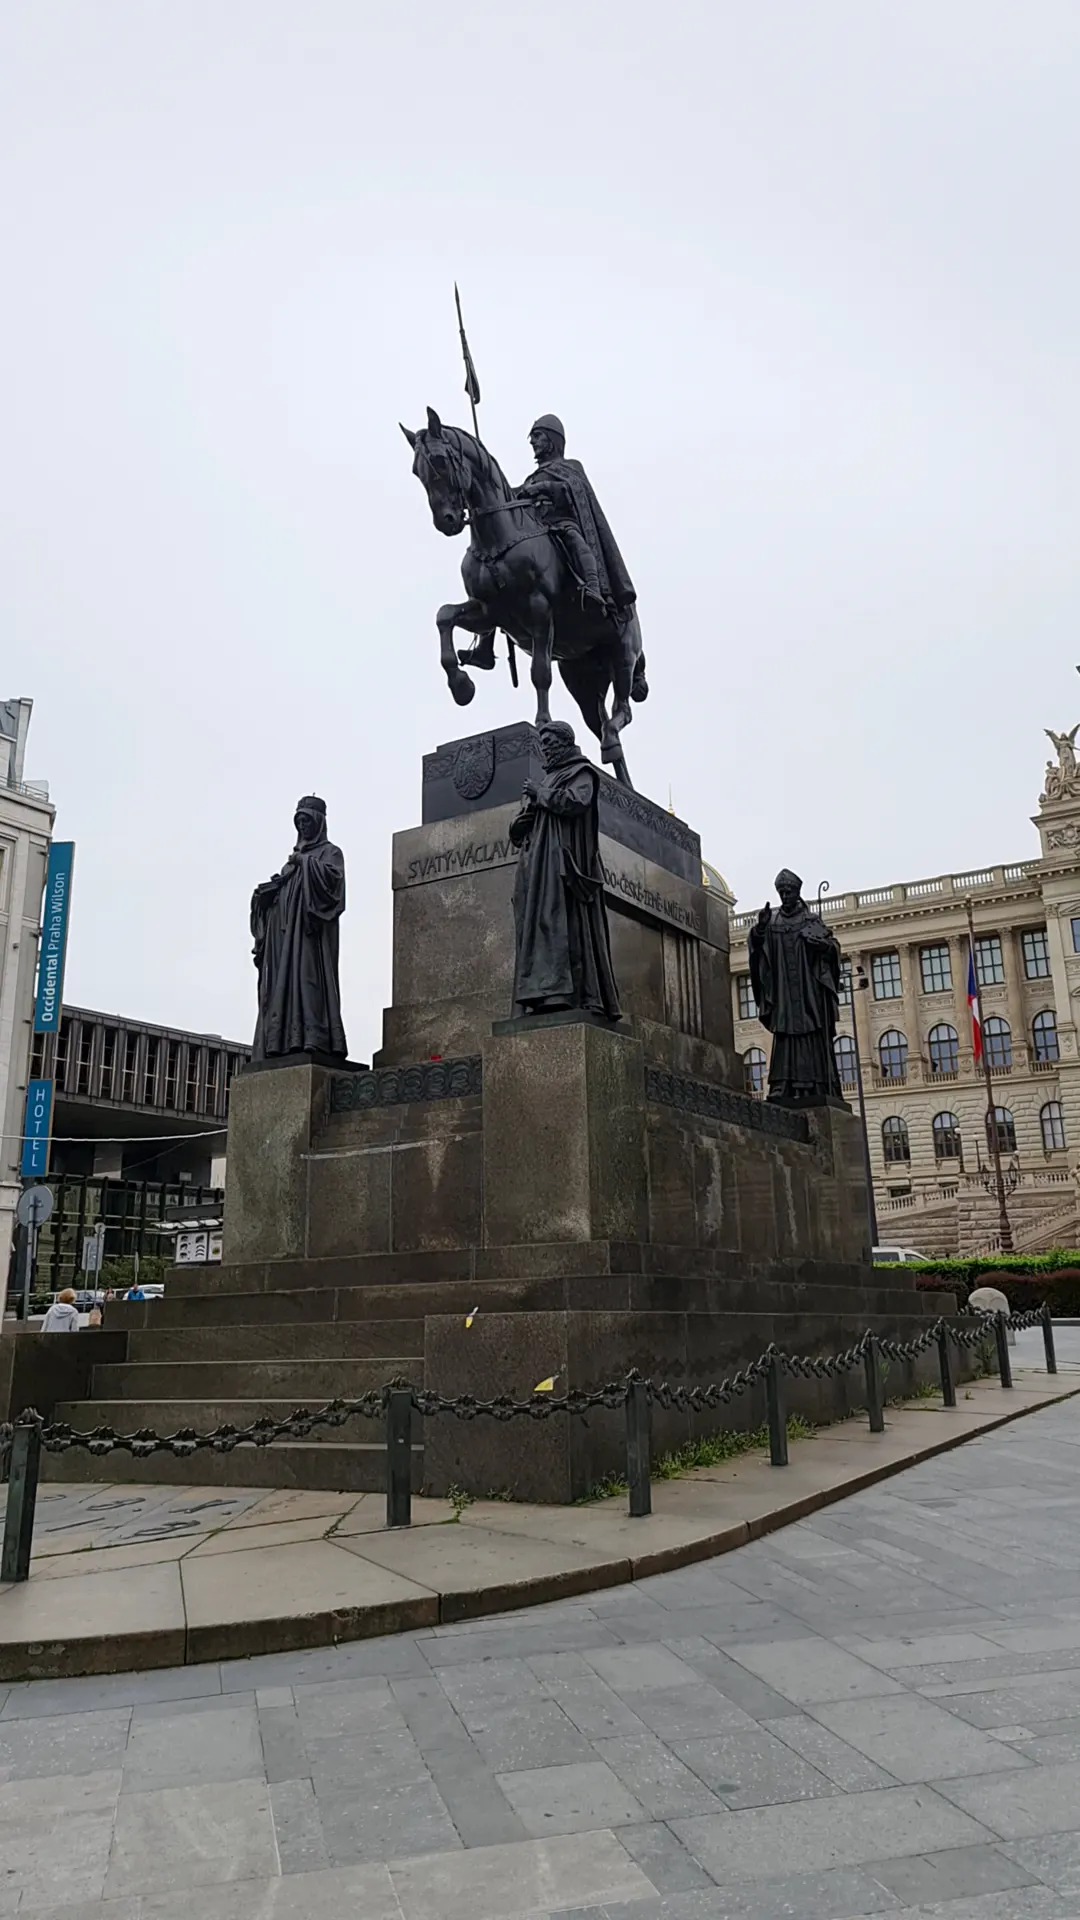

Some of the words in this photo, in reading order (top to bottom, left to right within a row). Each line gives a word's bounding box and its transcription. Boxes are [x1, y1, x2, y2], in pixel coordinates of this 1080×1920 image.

[51, 872, 65, 913] Wilson
[48, 916, 62, 950] Praha
[42, 954, 58, 1022] Occidental
[31, 1088, 46, 1167] HOTEL
